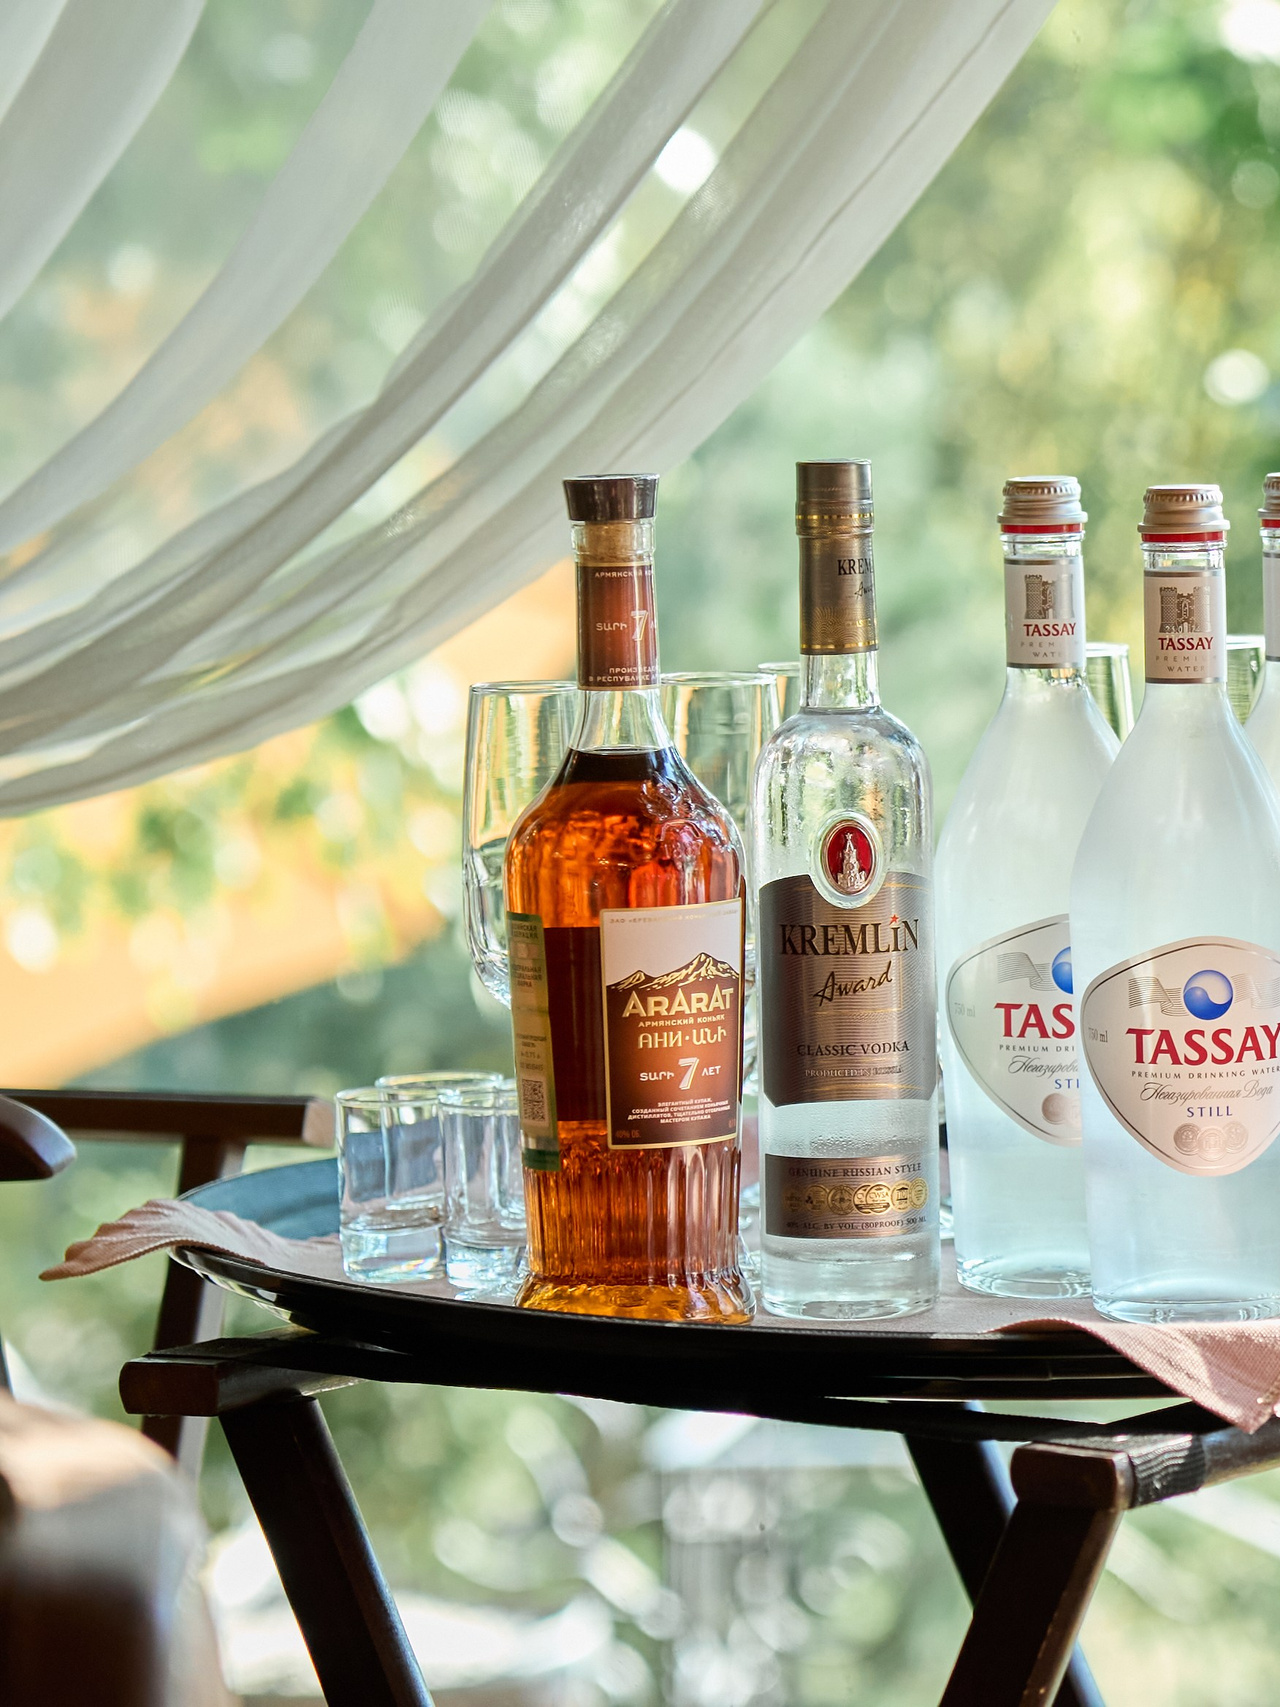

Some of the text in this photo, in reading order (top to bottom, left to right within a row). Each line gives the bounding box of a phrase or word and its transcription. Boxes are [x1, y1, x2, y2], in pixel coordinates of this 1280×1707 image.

[595, 569, 643, 578] АРМЯНСКЙ
[837, 558, 873, 576] KREM
[630, 609, 648, 642] 7
[1023, 623, 1076, 637] TASSAY
[1158, 637, 1214, 651] TASSAY
[779, 915, 919, 956] KREMLIN
[813, 961, 893, 1007] Award
[622, 984, 734, 1018] ARARAT
[638, 1014, 725, 1028] АРМЯНСКИЙ КОНЬЯК
[994, 1002, 1076, 1040] TAS
[1099, 1030, 1108, 1043] ml
[797, 1040, 910, 1056] CLASSIC VODKA
[1000, 1044, 1049, 1052] PREMIUM
[678, 1057, 700, 1090] 7
[702, 1065, 721, 1077] ЛЕТ
[805, 1068, 857, 1077] PRODUCED
[1131, 1065, 1280, 1079] PREMIUM DRINKING WATER
[1055, 1078, 1079, 1090] STI
[1140, 1079, 1274, 1106] Негазированная Вода
[1187, 1105, 1233, 1118] STILL
[789, 1163, 922, 1178] GENUINE RUSSIAN STYLE
